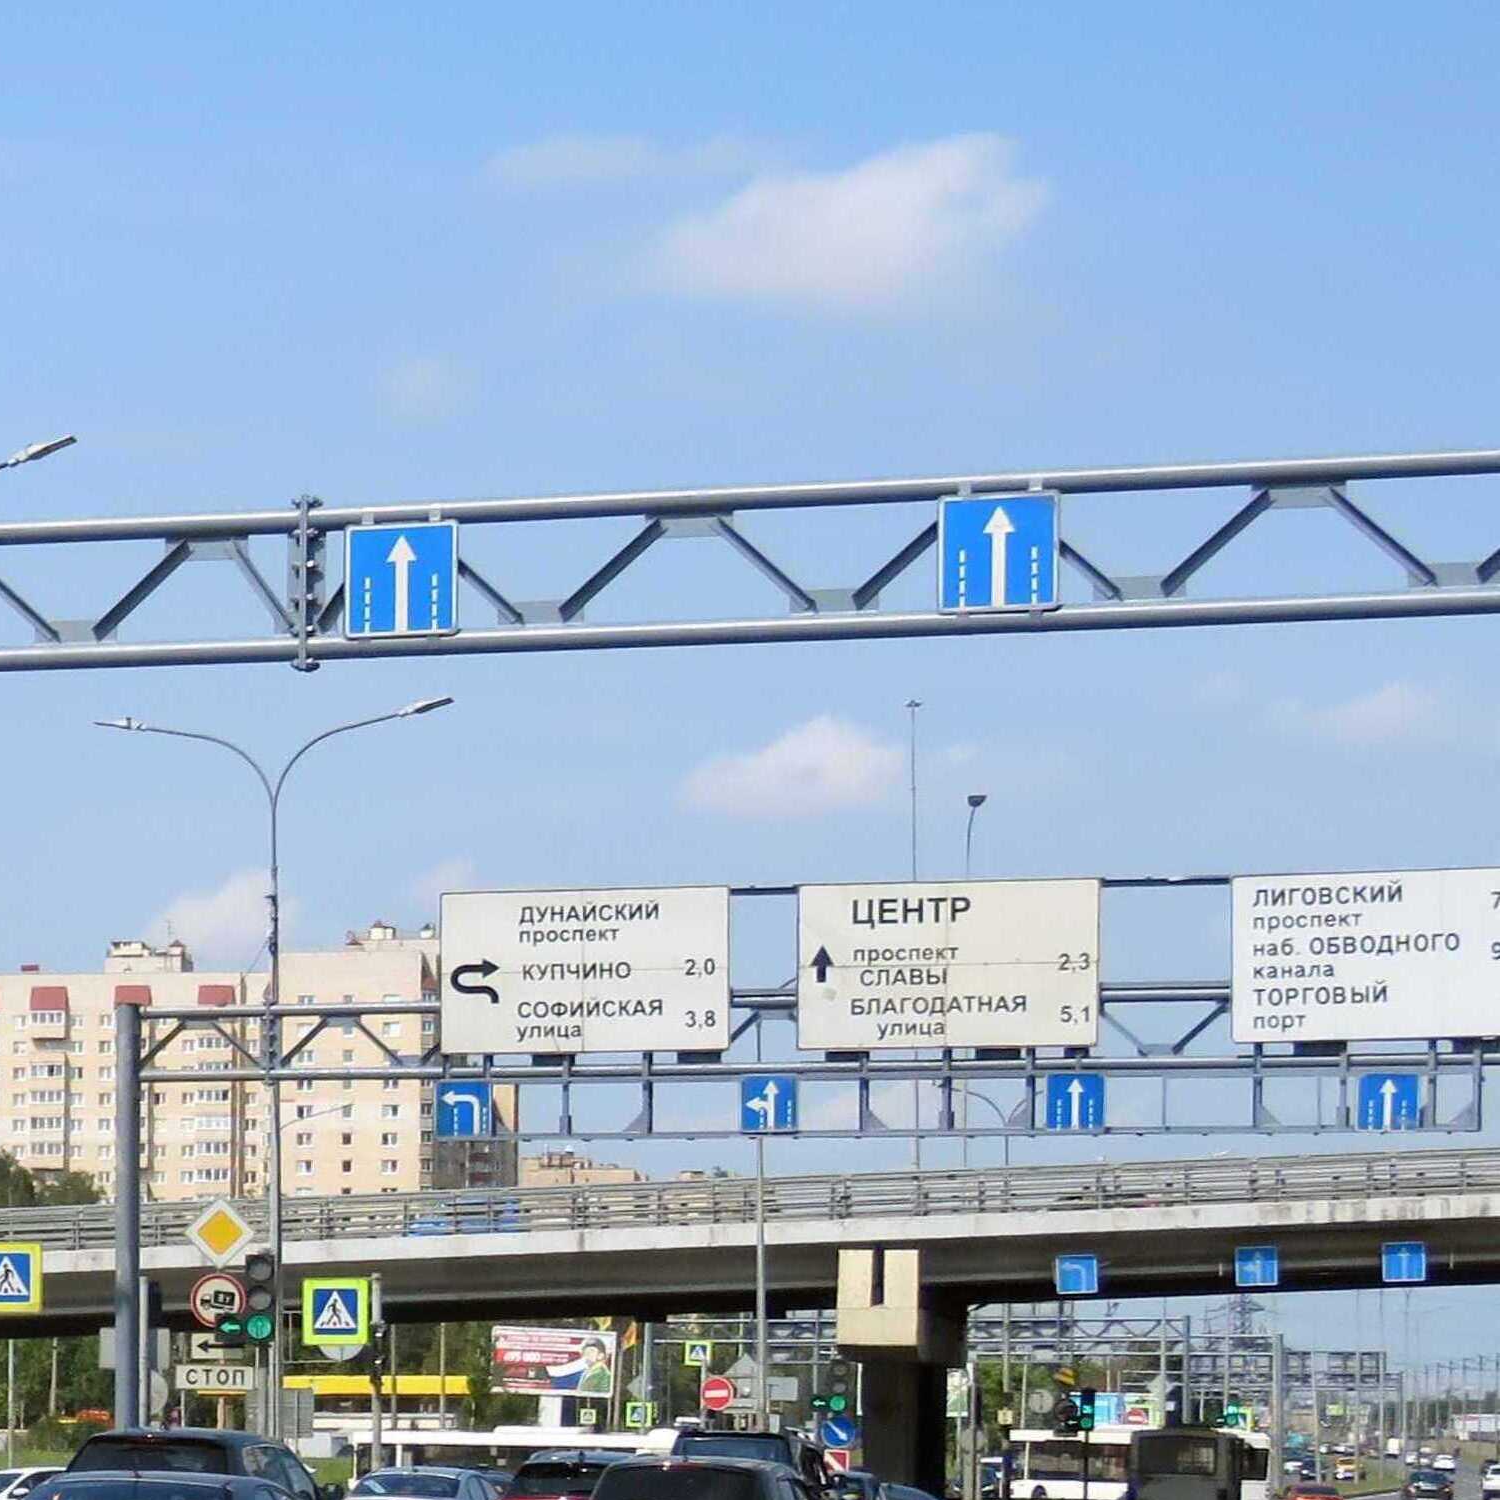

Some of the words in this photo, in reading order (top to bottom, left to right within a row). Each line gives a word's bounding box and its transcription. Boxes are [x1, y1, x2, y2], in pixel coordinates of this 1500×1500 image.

[1253, 881, 1403, 907] ЛИГОВСКИЙ
[519, 900, 660, 926] ДУНАЙСКИЙ
[852, 897, 971, 929] ЦЕНТР
[1253, 911, 1363, 934] проспект
[519, 927, 620, 946] проспект
[1253, 939, 1301, 957] наб.
[1309, 932, 1461, 956] ОБВОДНОГО
[522, 961, 631, 981] КУПЧИНО
[684, 958, 716, 978] 2,0
[853, 946, 959, 966] проспект
[1059, 953, 1090, 973] 2,3
[860, 968, 947, 987] СЛАВЫ
[1253, 964, 1335, 980] канала
[1253, 981, 1389, 1006] ТОРГОВЫЙ
[517, 998, 663, 1019] СОФИЙСКАЯ
[684, 1011, 716, 1030] 3,8
[850, 995, 1027, 1017] БЛАГОДАТНАЯ
[1059, 1006, 1090, 1025] 5,1
[516, 1024, 582, 1041] улица
[877, 1022, 946, 1040] улица
[1253, 1014, 1306, 1032] порт
[186, 1369, 245, 1385] СТОП
